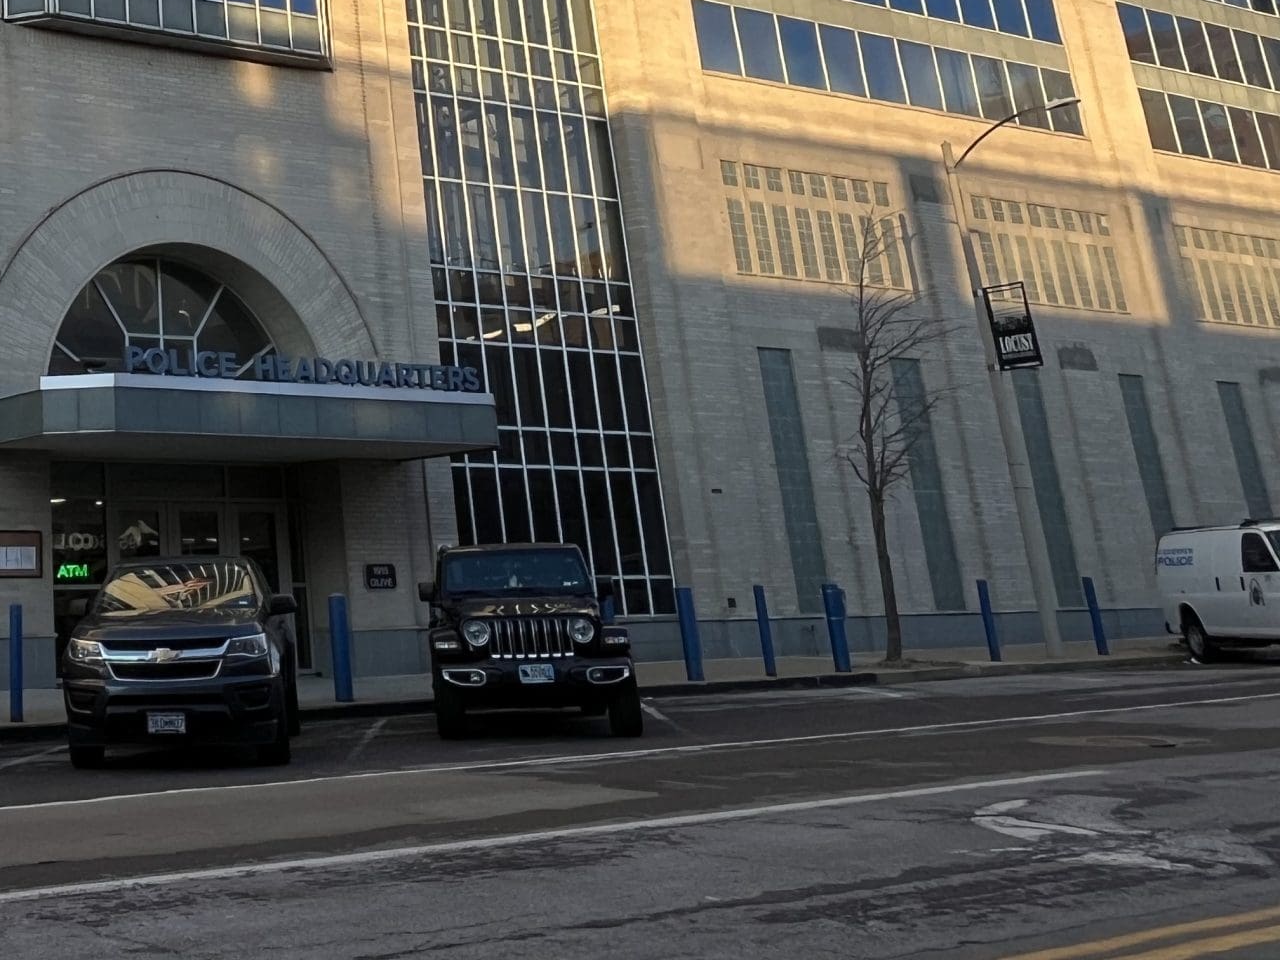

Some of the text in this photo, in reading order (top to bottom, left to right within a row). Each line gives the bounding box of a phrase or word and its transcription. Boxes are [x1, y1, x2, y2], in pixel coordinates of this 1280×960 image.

[999, 333, 1033, 353] LOCUST
[125, 345, 480, 392] POLICE HEADQUARTERS
[57, 564, 88, 578] ATM
[370, 577, 394, 587] OLIVE
